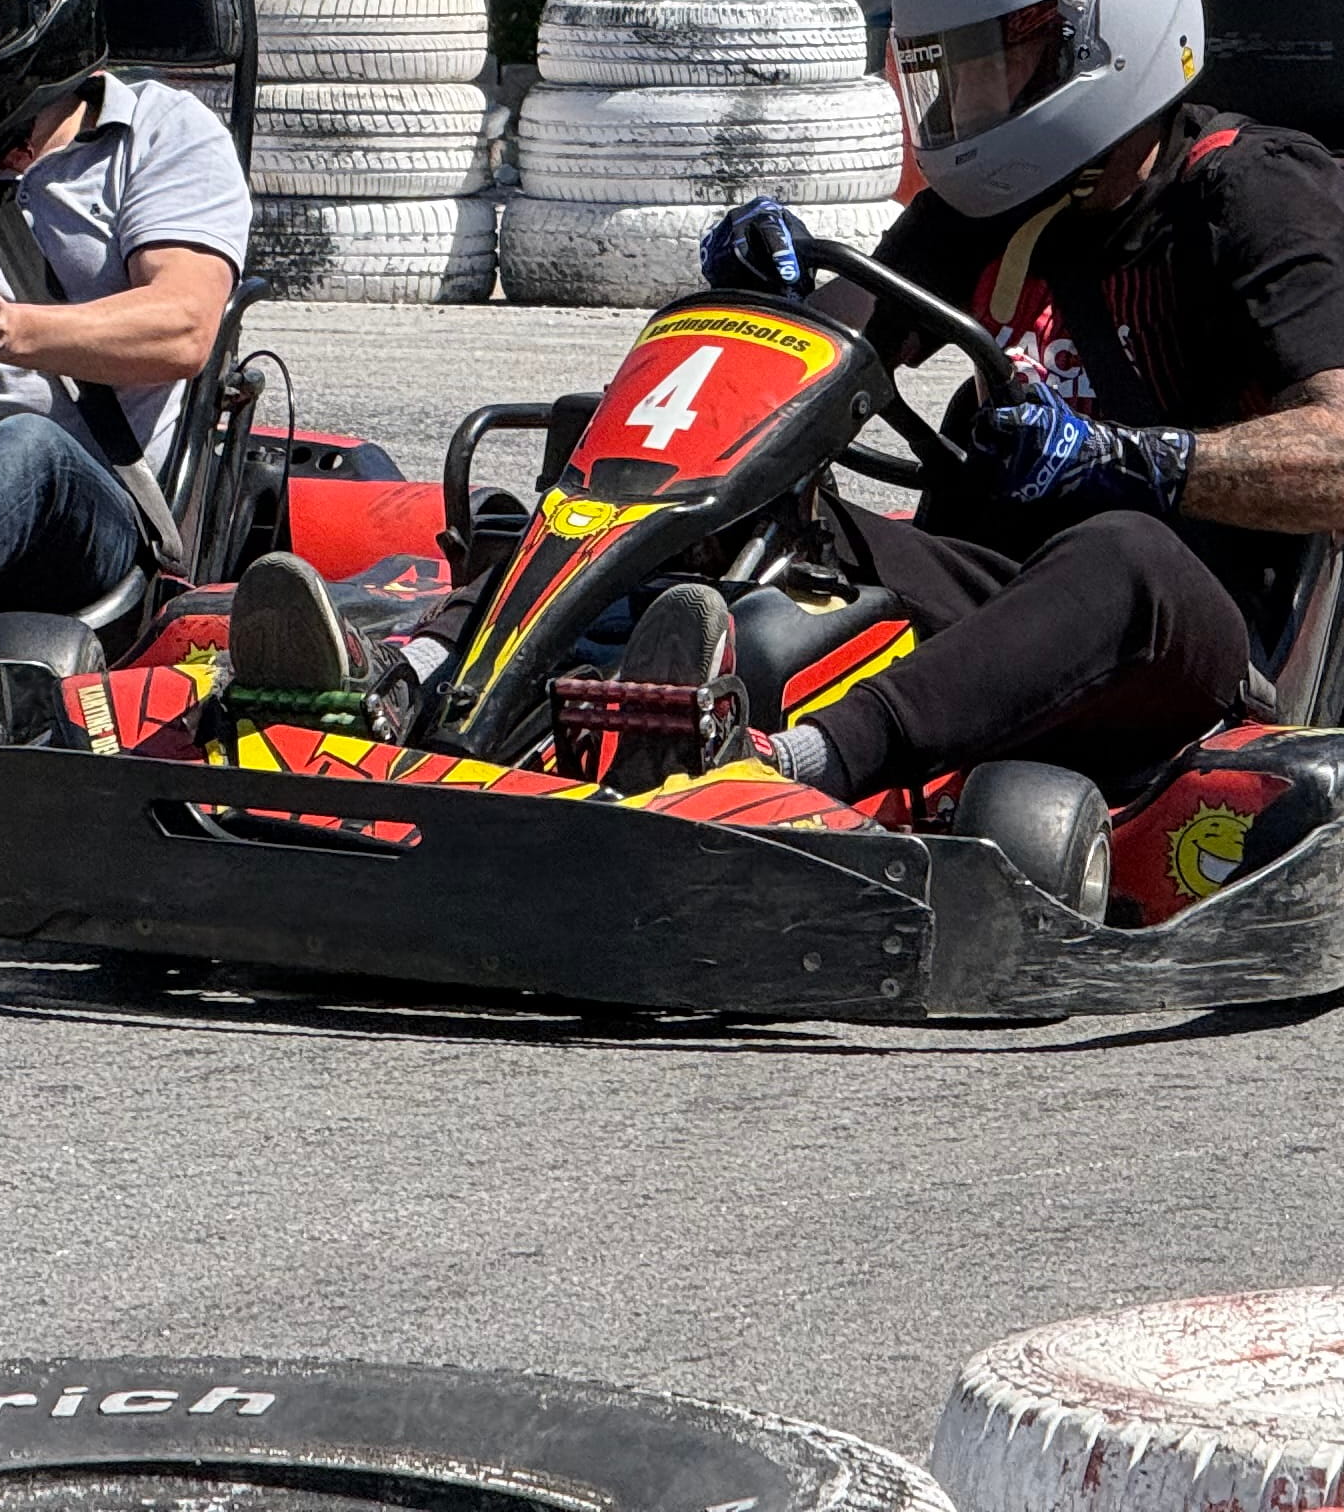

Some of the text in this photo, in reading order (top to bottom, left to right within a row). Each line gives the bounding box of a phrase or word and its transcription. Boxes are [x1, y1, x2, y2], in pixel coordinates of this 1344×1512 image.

[624, 345, 725, 451] 4
[1009, 421, 1080, 504] parco
[91, 734, 121, 756] DE
